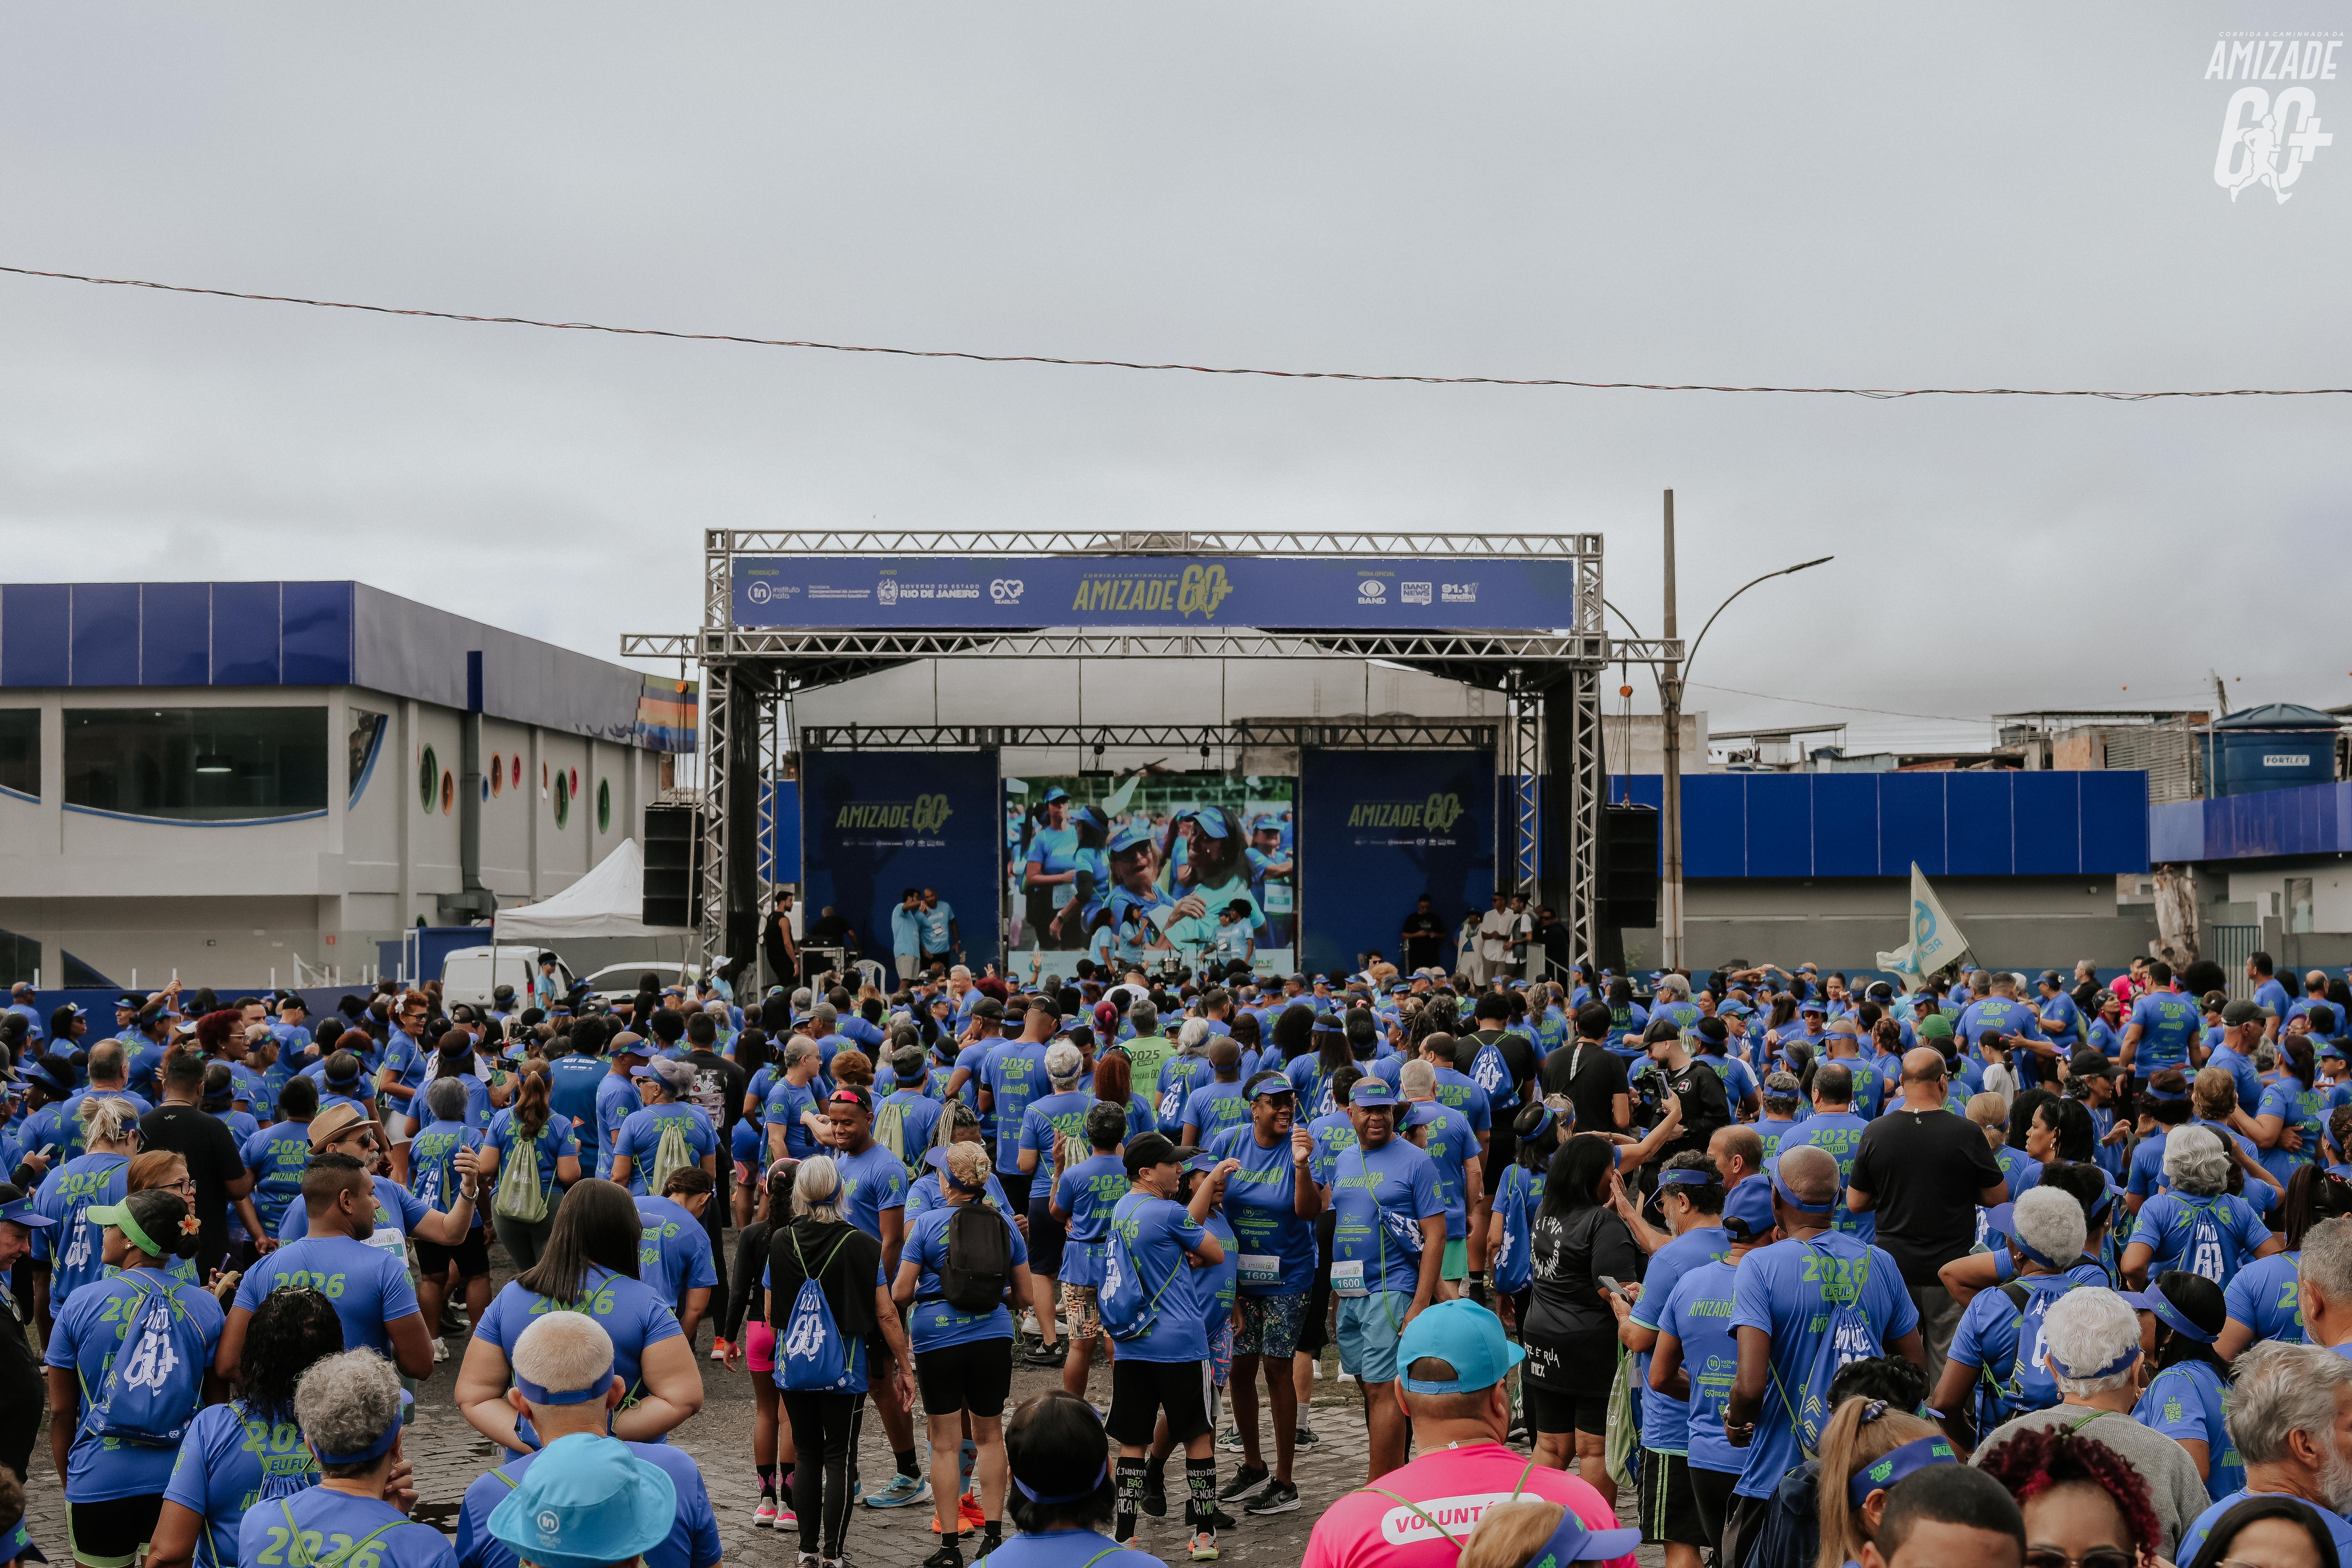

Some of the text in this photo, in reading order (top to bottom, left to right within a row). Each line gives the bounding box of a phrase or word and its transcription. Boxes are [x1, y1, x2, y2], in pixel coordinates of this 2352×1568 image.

[900, 590, 980, 598] RIO DE JANEIRO
[1072, 580, 1178, 611] AMIZADE
[1177, 564, 1234, 613] 60+
[1442, 583, 1468, 593] 91.1
[835, 805, 913, 828] AMIZADE
[1347, 804, 1424, 827] AMIZADE
[1132, 1050, 1161, 1061] 2025
[999, 1056, 1034, 1072] 2026
[1437, 1084, 1472, 1098] 2026
[1209, 1096, 1247, 1112] 2026
[653, 1116, 695, 1132] 2026
[1322, 1126, 1355, 1140] 202
[1809, 1128, 1862, 1144] 2026
[55, 1171, 110, 1195] 2026
[1089, 1175, 1128, 1192] 202
[1233, 1170, 1268, 1183] AMIZADE
[1245, 1271, 1274, 1281] 1602
[1802, 1255, 1868, 1284] 2026
[1337, 1278, 1360, 1289] 1600
[1688, 1301, 1732, 1318] AMIZADE
[786, 1313, 826, 1353] 60+
[1544, 1348, 1560, 1368] RUA
[2165, 1411, 2182, 1420] 165
[271, 1458, 290, 1471] EU
[1119, 1488, 1134, 1497] QUE
[1118, 1499, 1133, 1514] FICA
[257, 1526, 387, 1568] 2026
